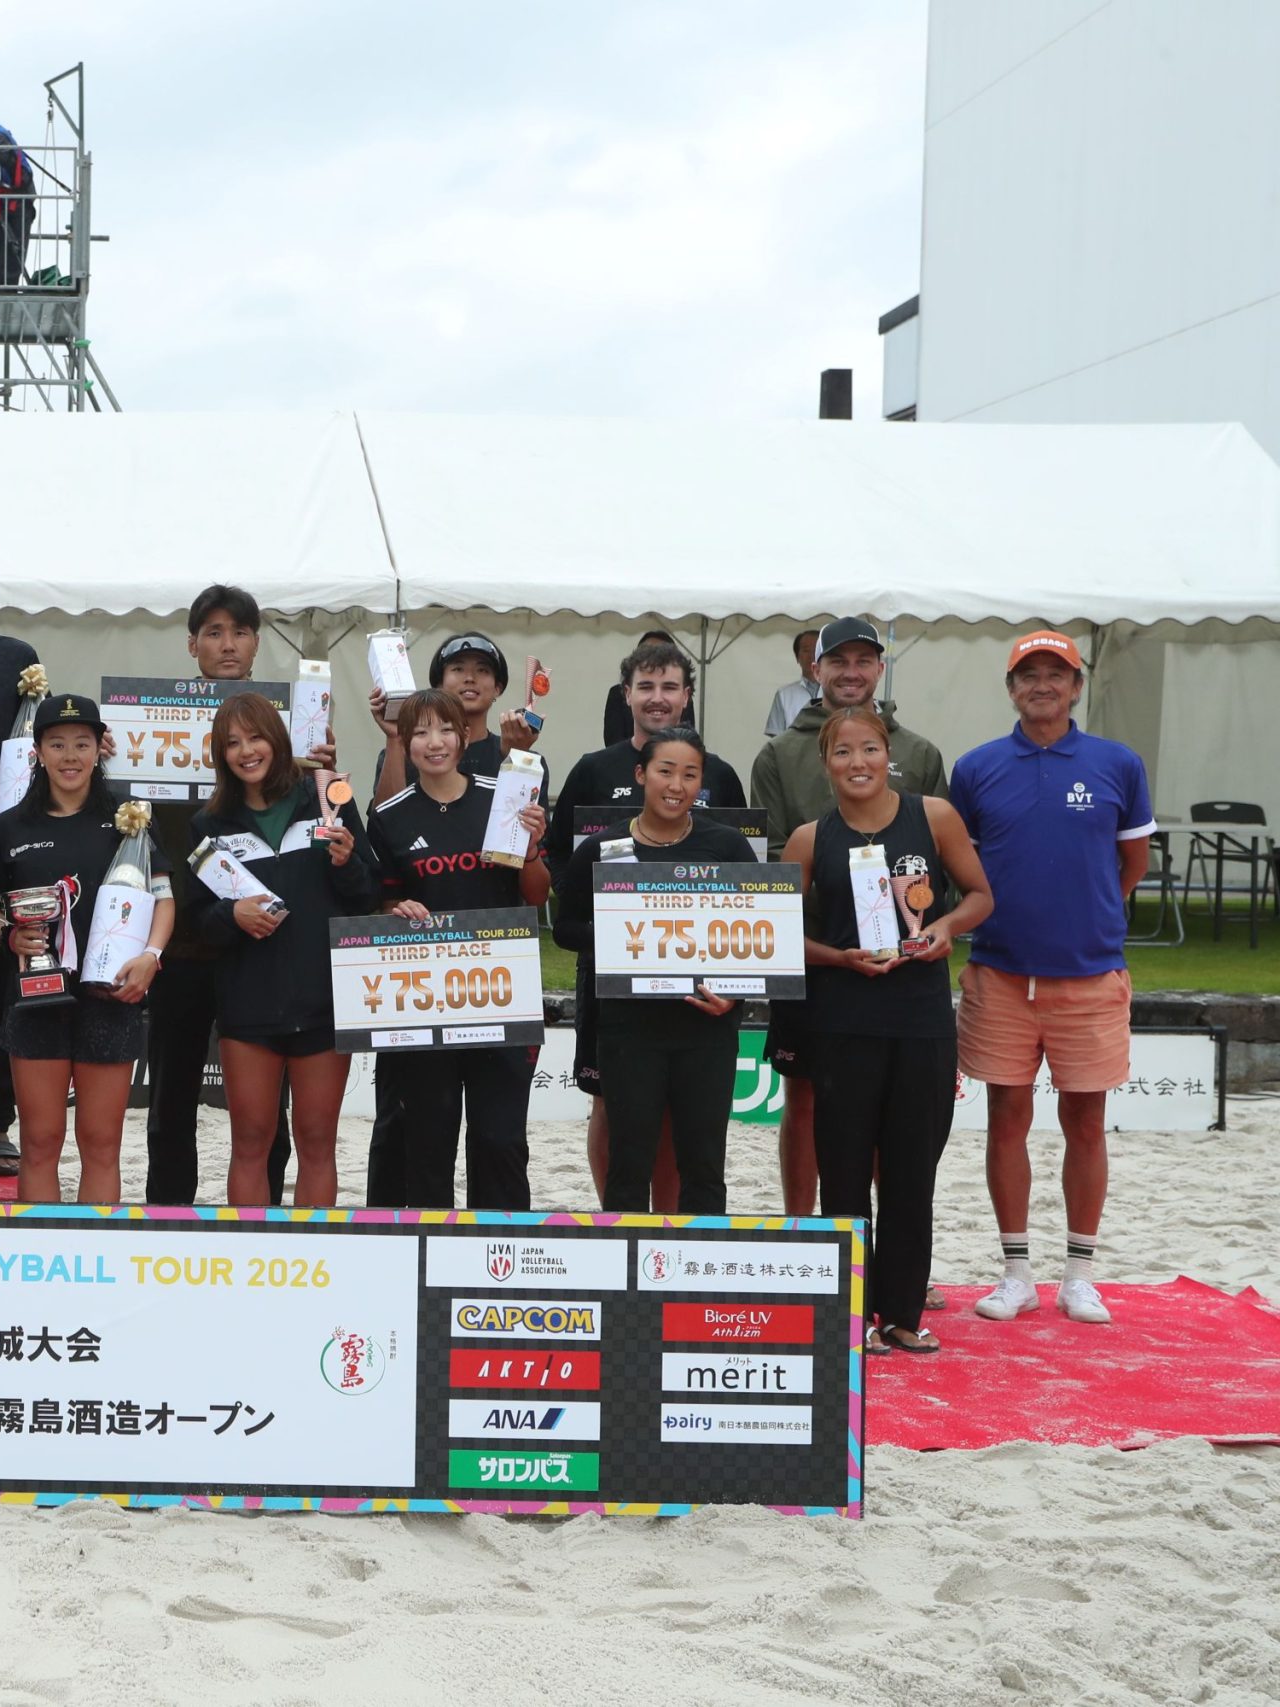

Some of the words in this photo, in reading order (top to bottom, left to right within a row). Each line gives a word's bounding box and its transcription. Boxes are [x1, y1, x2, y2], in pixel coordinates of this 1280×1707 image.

[189, 682, 217, 694] BVT
[140, 696, 223, 706] BEACHVOLLEYBA
[144, 708, 191, 721] THIRD
[1067, 793, 1092, 803] BVT
[689, 865, 719, 879] BVT
[601, 883, 633, 891] JAPAN
[637, 883, 737, 891] BEACHVOLLEYBALL
[741, 883, 768, 891] TOUR
[771, 883, 794, 891] 2026
[641, 896, 693, 908] THIRD
[700, 896, 755, 908] PLACE
[424, 915, 455, 929] BVT
[338, 937, 370, 946] JAPAN
[373, 932, 473, 945] BEACHVOLLEYBALL
[476, 929, 504, 938] TOUR
[508, 928, 531, 937] 2026
[624, 920, 775, 962] ¥75,000
[378, 947, 429, 961] THIRD
[436, 943, 491, 958] PLACE
[362, 966, 512, 1013] ¥75,000
[490, 1245, 511, 1255] JVA
[521, 1257, 564, 1265] VOLLEYBALL
[130, 1256, 233, 1286] TOUR
[247, 1259, 330, 1288] 2026
[521, 1267, 567, 1275] ASSOCIATION
[684, 1261, 834, 1278] 霧島酒造株式会社
[457, 1305, 595, 1334] CAPCOM
[705, 1309, 746, 1323] Bioré
[750, 1312, 772, 1324] UV
[712, 1326, 761, 1337] Athlizm
[725, 1357, 752, 1366] メリット
[687, 1363, 786, 1390] merit
[482, 1409, 537, 1430] ANA
[479, 1457, 569, 1483] サロンパス
